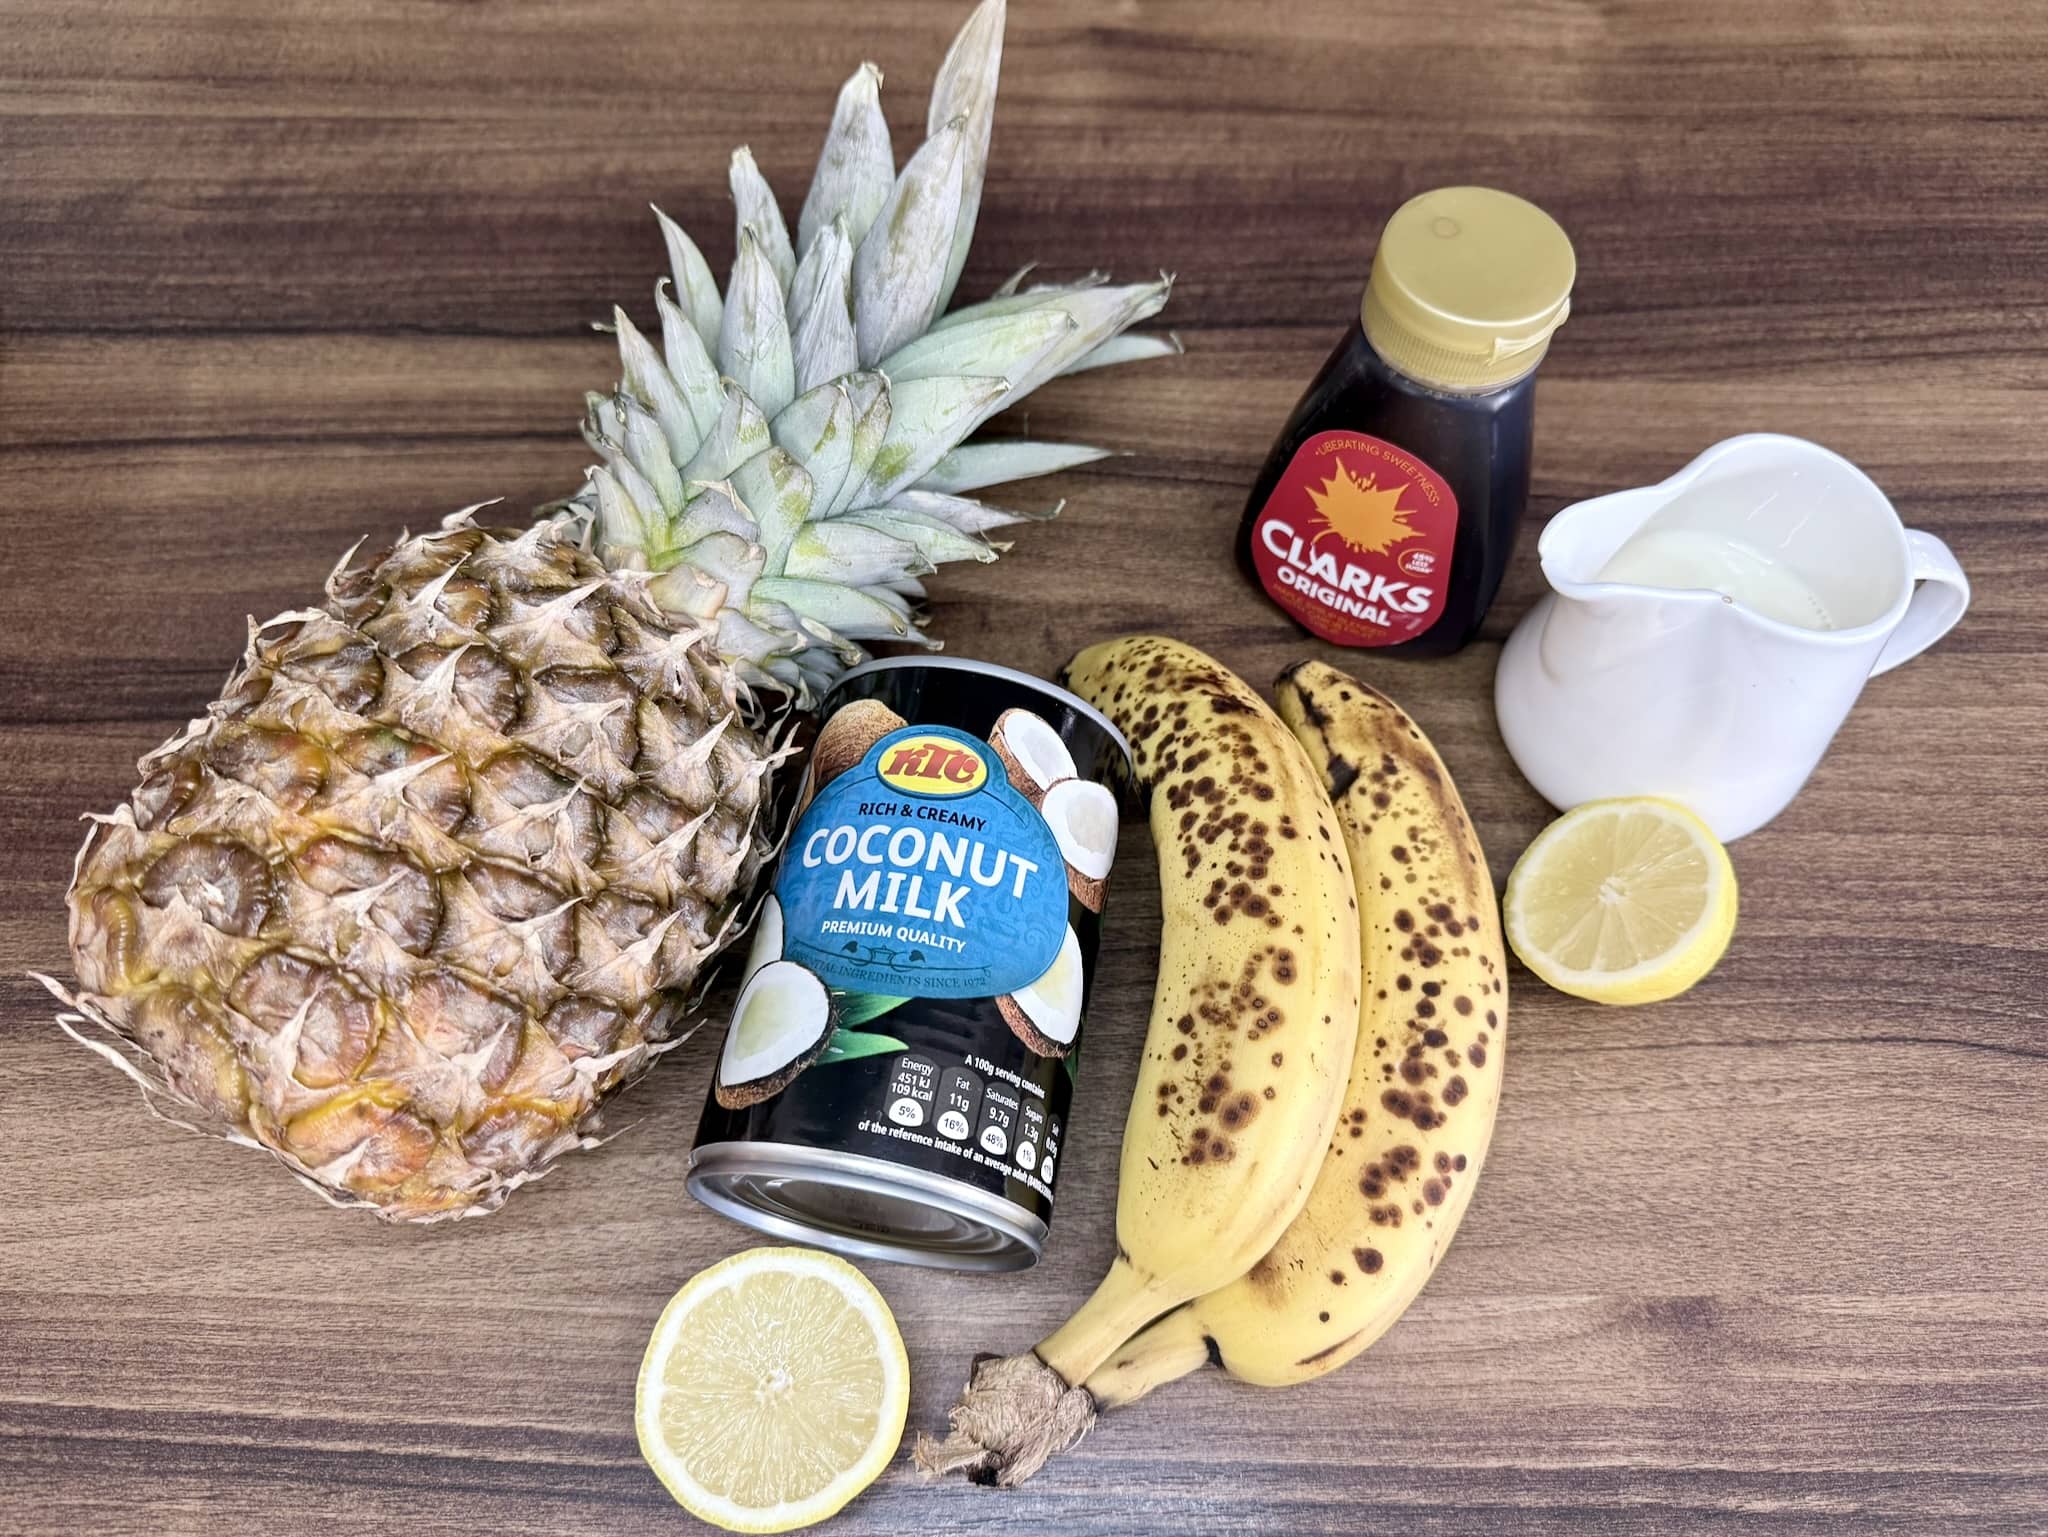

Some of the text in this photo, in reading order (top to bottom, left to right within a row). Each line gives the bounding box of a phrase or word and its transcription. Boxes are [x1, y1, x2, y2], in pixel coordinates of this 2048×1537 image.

[1319, 440, 1440, 504] LIBERATING SWEETNESS
[1261, 519, 1433, 614] CLARKS
[1276, 566, 1391, 627] ORIGINAL
[858, 802, 987, 832] RICH & CREAMY
[802, 824, 1038, 899] COCONUT
[832, 869, 972, 929] MILK
[821, 920, 967, 953] PREMIUM QUALITY
[839, 965, 921, 985] INGREDIENTS
[923, 976, 961, 988] SINCE
[963, 976, 986, 987] 1972
[901, 1057, 934, 1077] Energy
[964, 1054, 972, 1066] A
[974, 1056, 994, 1076] 100g
[994, 1066, 1021, 1088] serving
[897, 1072, 931, 1088] 451 kJ
[955, 1076, 970, 1091] Fat
[891, 1082, 933, 1102] 109 kcal
[949, 1092, 970, 1112] 11g
[985, 1087, 1019, 1110] Saturates
[898, 1105, 916, 1119] 5%
[988, 1106, 1010, 1129] 9.7g
[943, 1117, 965, 1133] 16%
[1024, 1122, 1039, 1144] 1.3g
[858, 1119, 871, 1131] of
[870, 1121, 887, 1135] the
[888, 1127, 934, 1147] reference
[934, 1137, 963, 1156] intake
[962, 1147, 974, 1159] of
[972, 1152, 984, 1164] an
[984, 1157, 1012, 1177] average
[985, 1132, 1004, 1149] 48%
